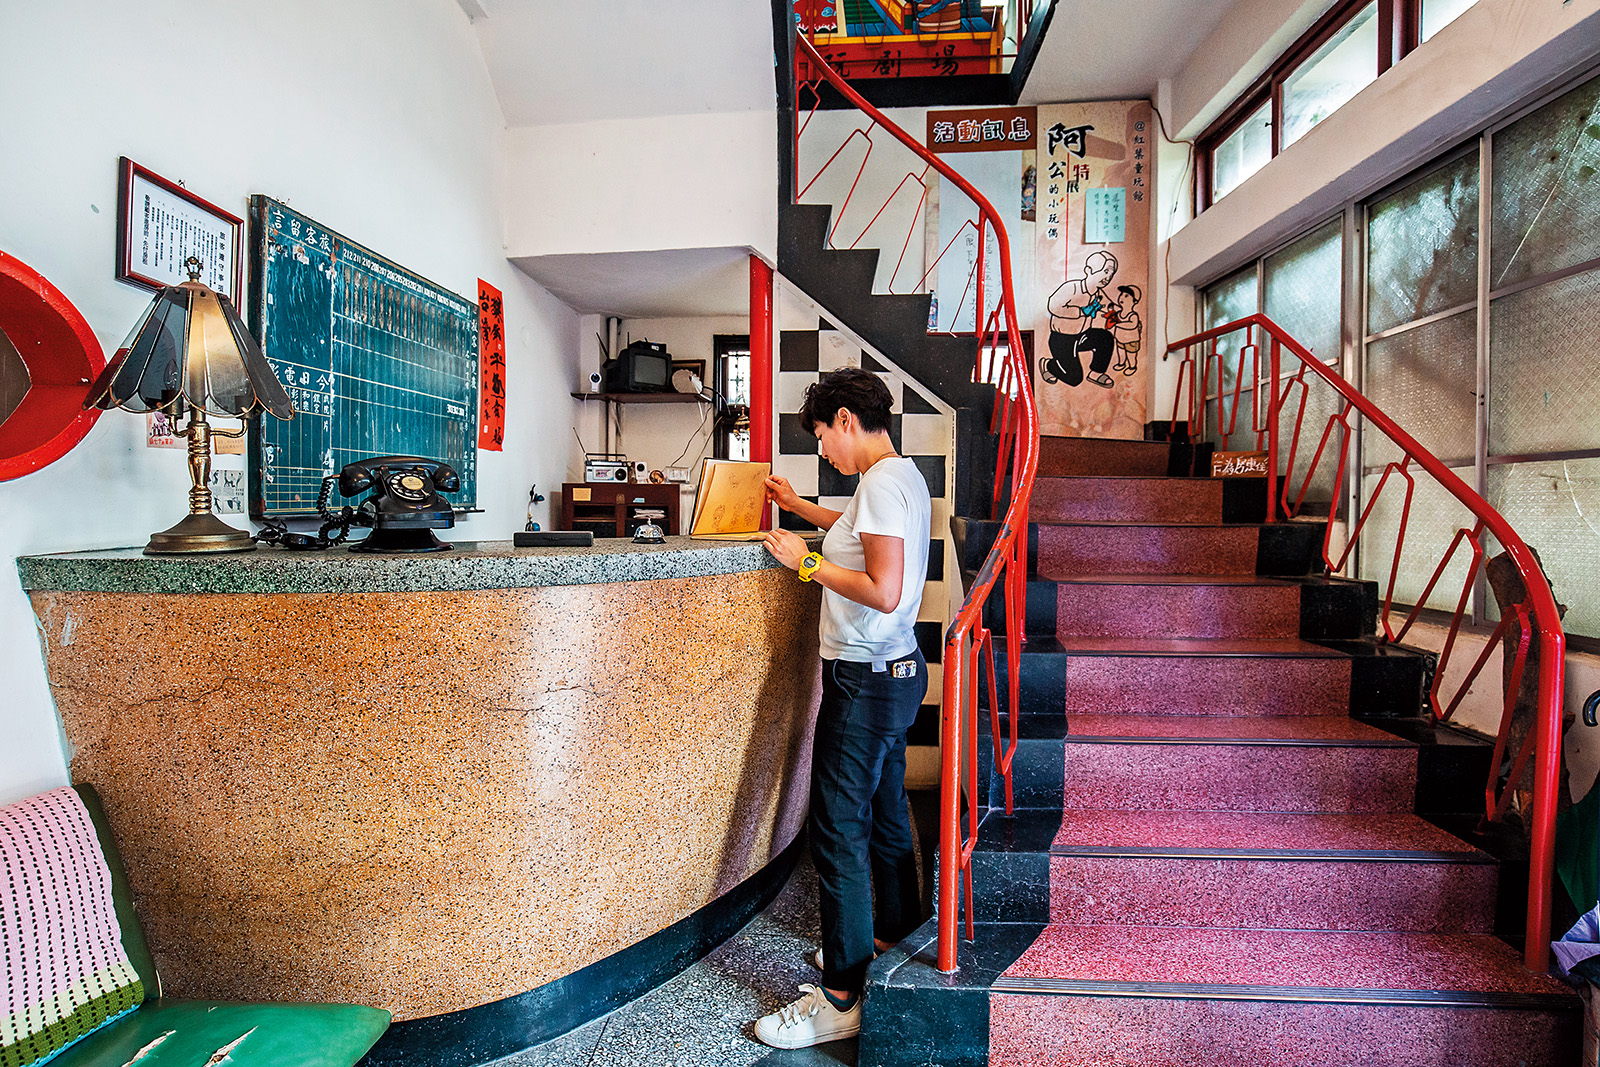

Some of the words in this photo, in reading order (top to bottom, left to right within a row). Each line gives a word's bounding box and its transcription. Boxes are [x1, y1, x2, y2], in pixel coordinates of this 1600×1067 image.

[933, 116, 1032, 144] 活動訊息
[1047, 122, 1095, 239] 阿公的小玩偶
[1066, 163, 1090, 194] 特展
[272, 209, 332, 253] 旅客留言
